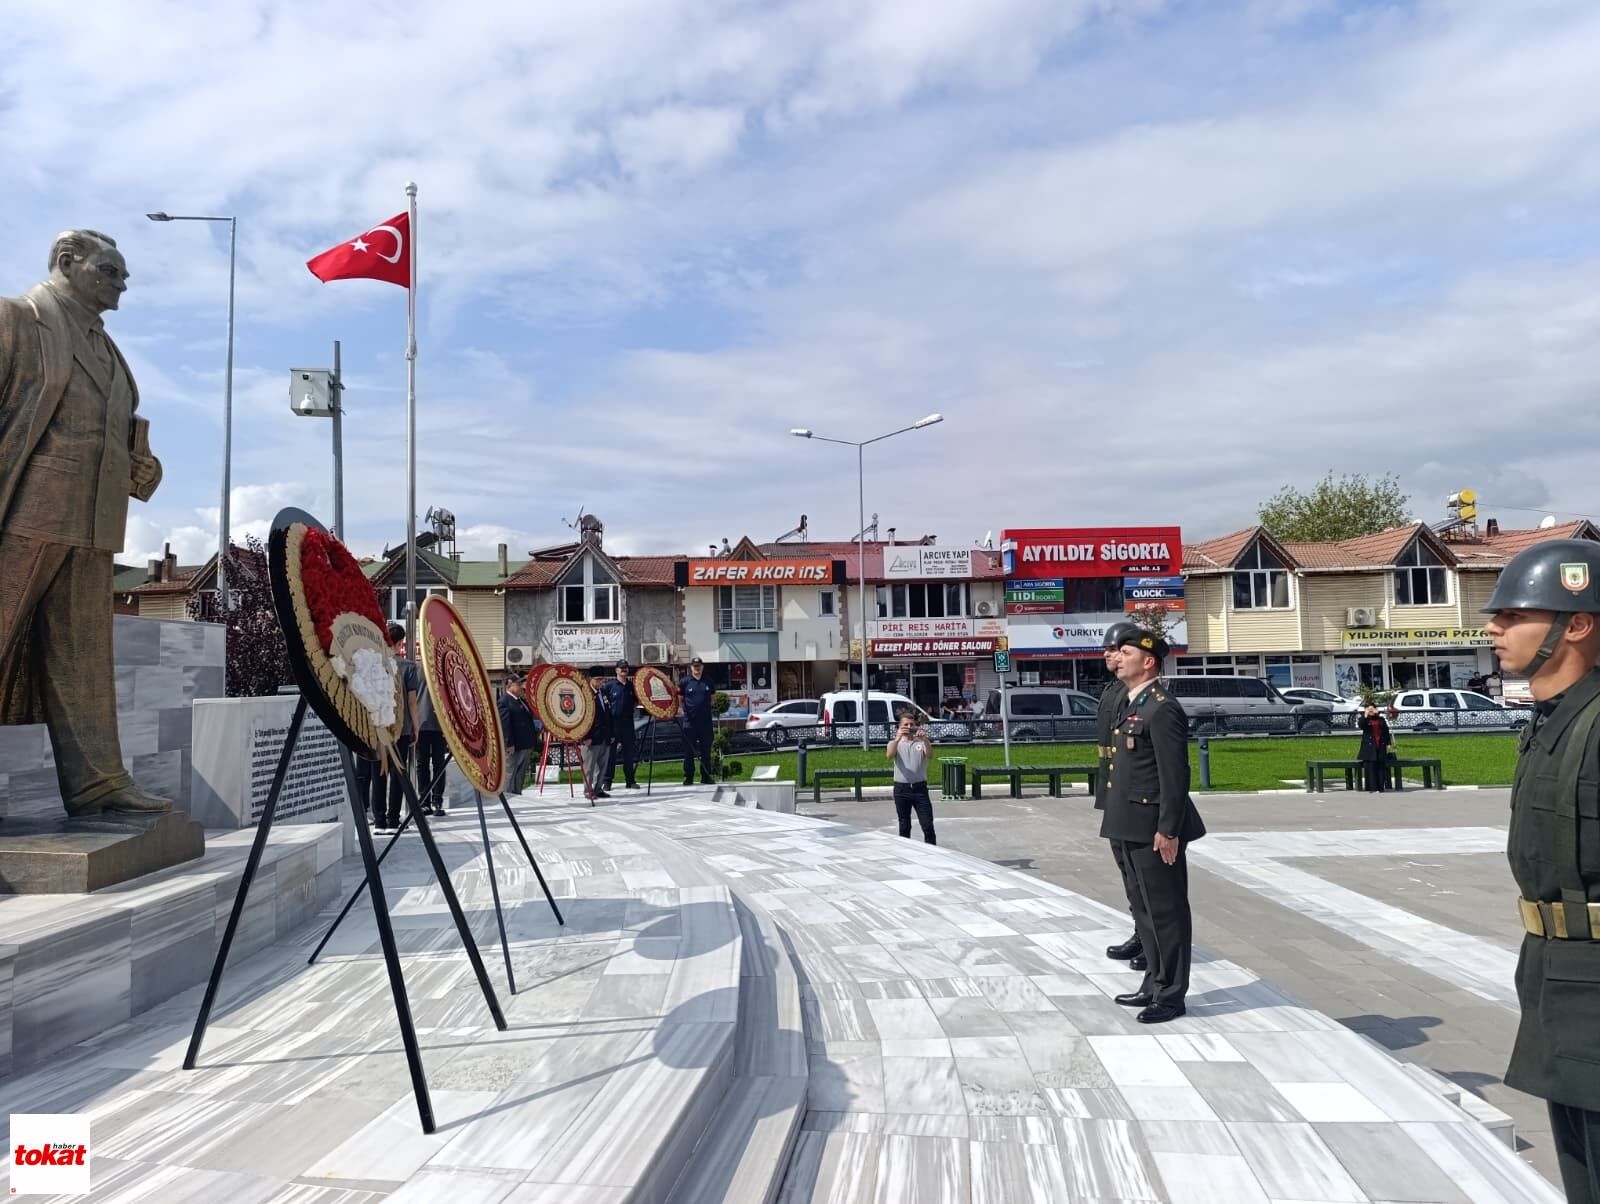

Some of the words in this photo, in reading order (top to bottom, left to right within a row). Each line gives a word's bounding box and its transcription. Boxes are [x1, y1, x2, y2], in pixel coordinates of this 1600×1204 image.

[952, 550, 969, 559] YAPI
[1022, 544, 1095, 561] AYYILDIZ
[1100, 540, 1170, 560] SİGORTA
[693, 566, 748, 580] ZAFER
[752, 566, 796, 580] AKOR
[1132, 589, 1162, 598] QUICK
[1348, 630, 1409, 640] YILDIRIM
[1413, 630, 1448, 638] GIDA
[1452, 629, 1489, 638] PAZA
[874, 643, 903, 652] LEZZET
[961, 641, 993, 650] SALONU
